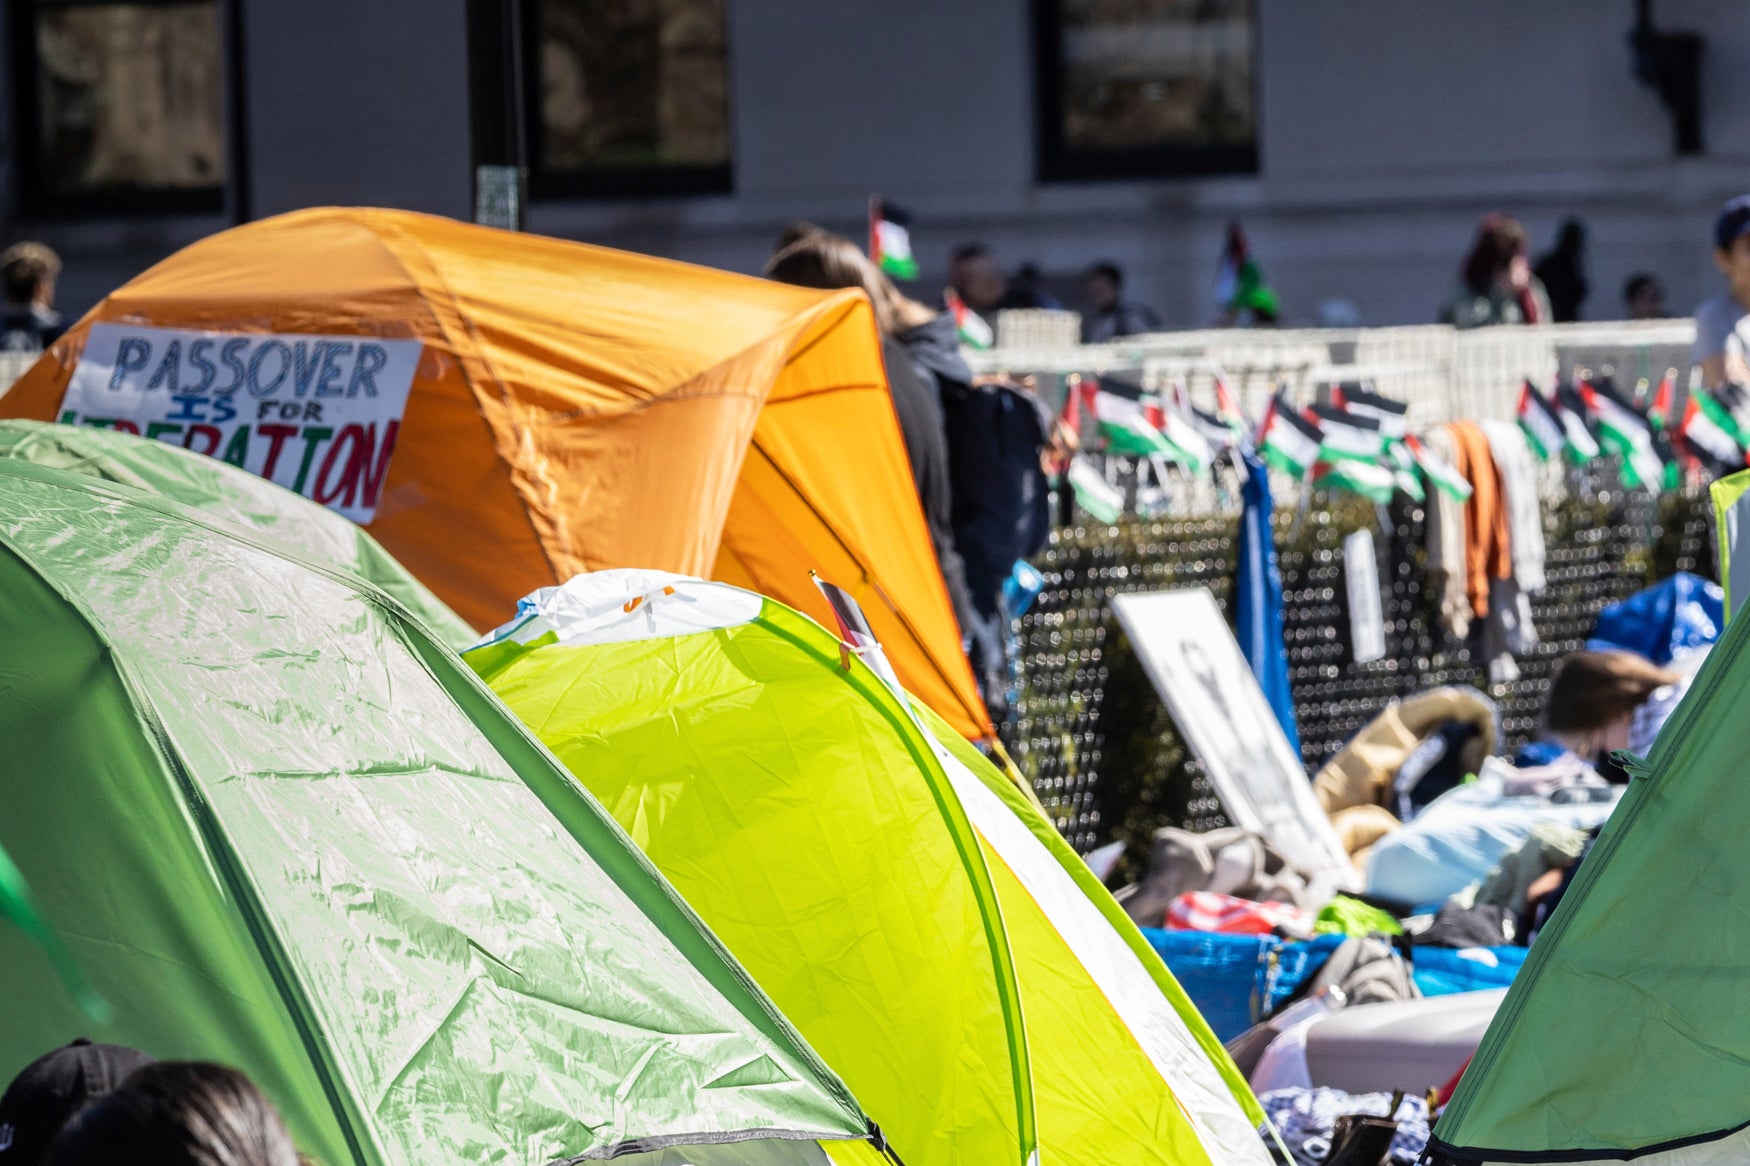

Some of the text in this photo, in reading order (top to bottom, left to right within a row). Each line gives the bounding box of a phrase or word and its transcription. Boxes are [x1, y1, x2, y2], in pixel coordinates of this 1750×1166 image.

[108, 337, 388, 400] PASSOVER
[166, 395, 324, 422] IS FOR
